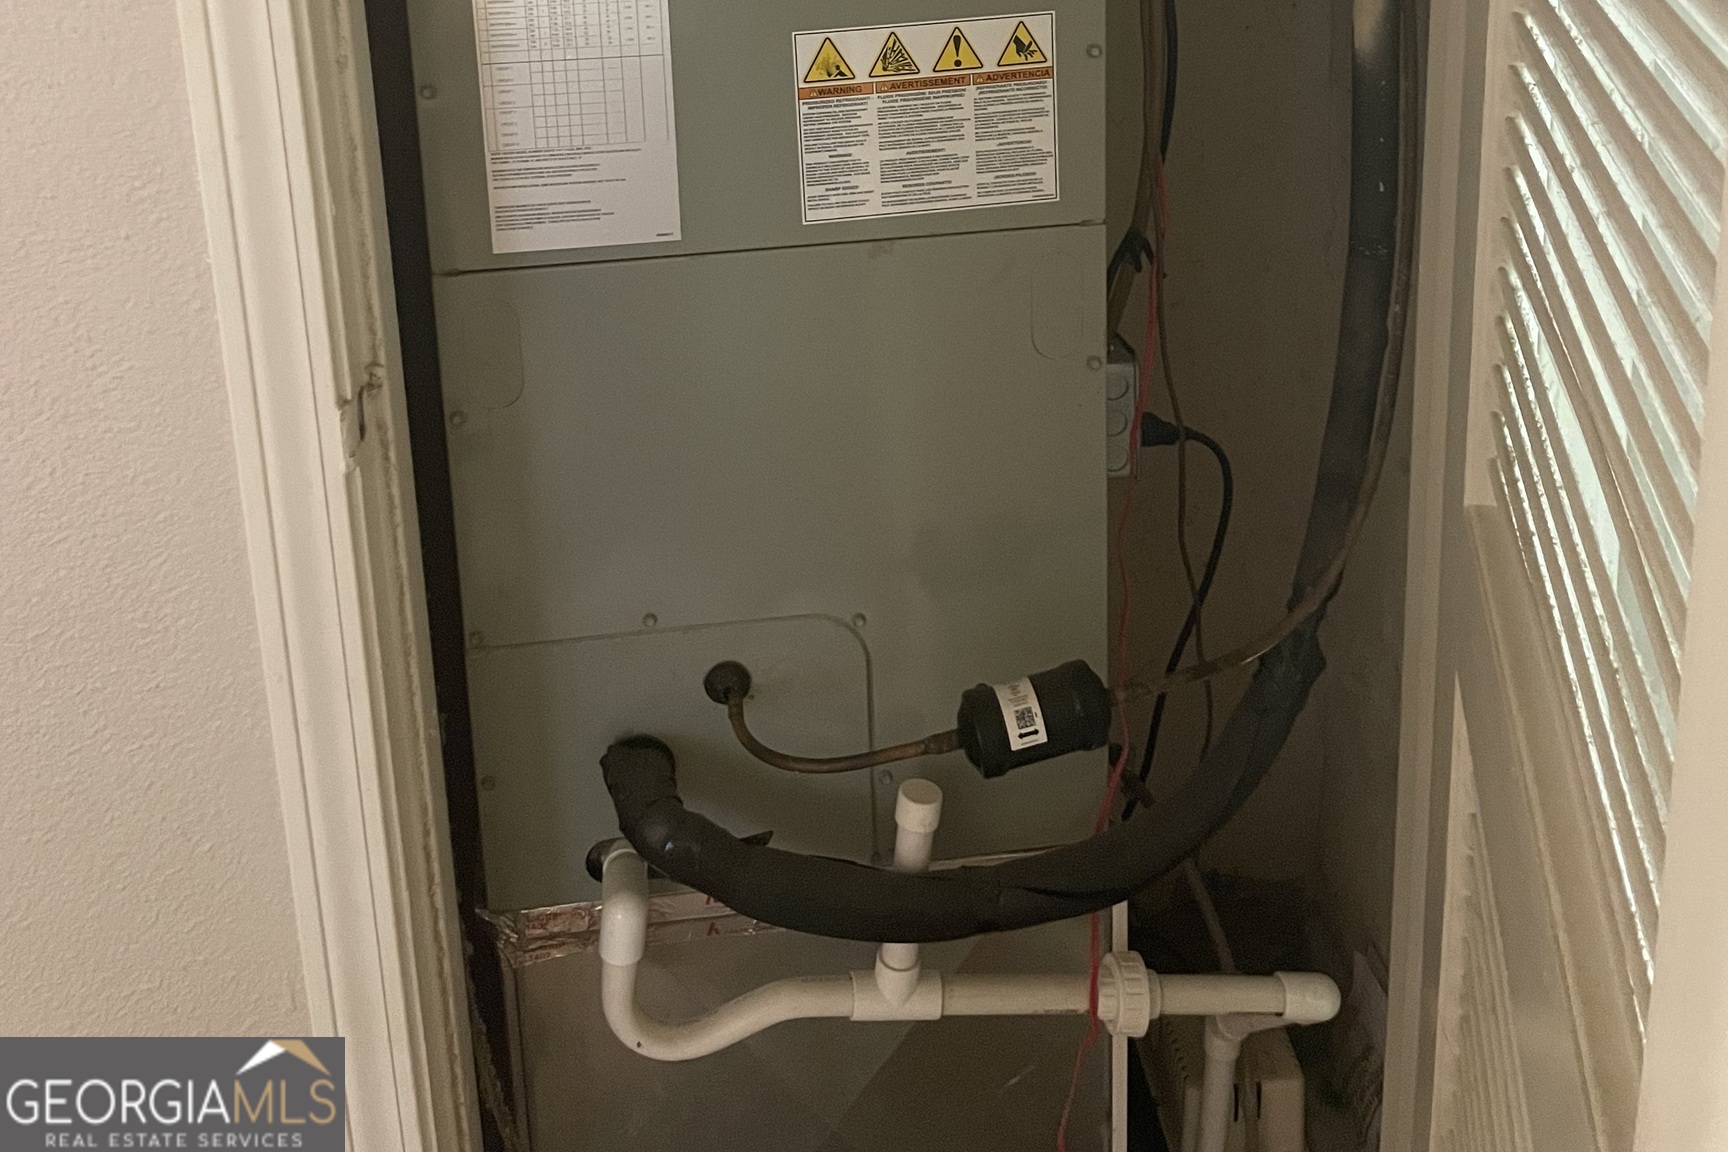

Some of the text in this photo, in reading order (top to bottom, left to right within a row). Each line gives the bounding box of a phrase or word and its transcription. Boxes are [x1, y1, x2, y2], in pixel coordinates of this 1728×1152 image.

[986, 69, 1050, 81] ADVERTENCIA
[889, 76, 966, 90] AVERTISSEMENT
[818, 86, 862, 96] WARNING
